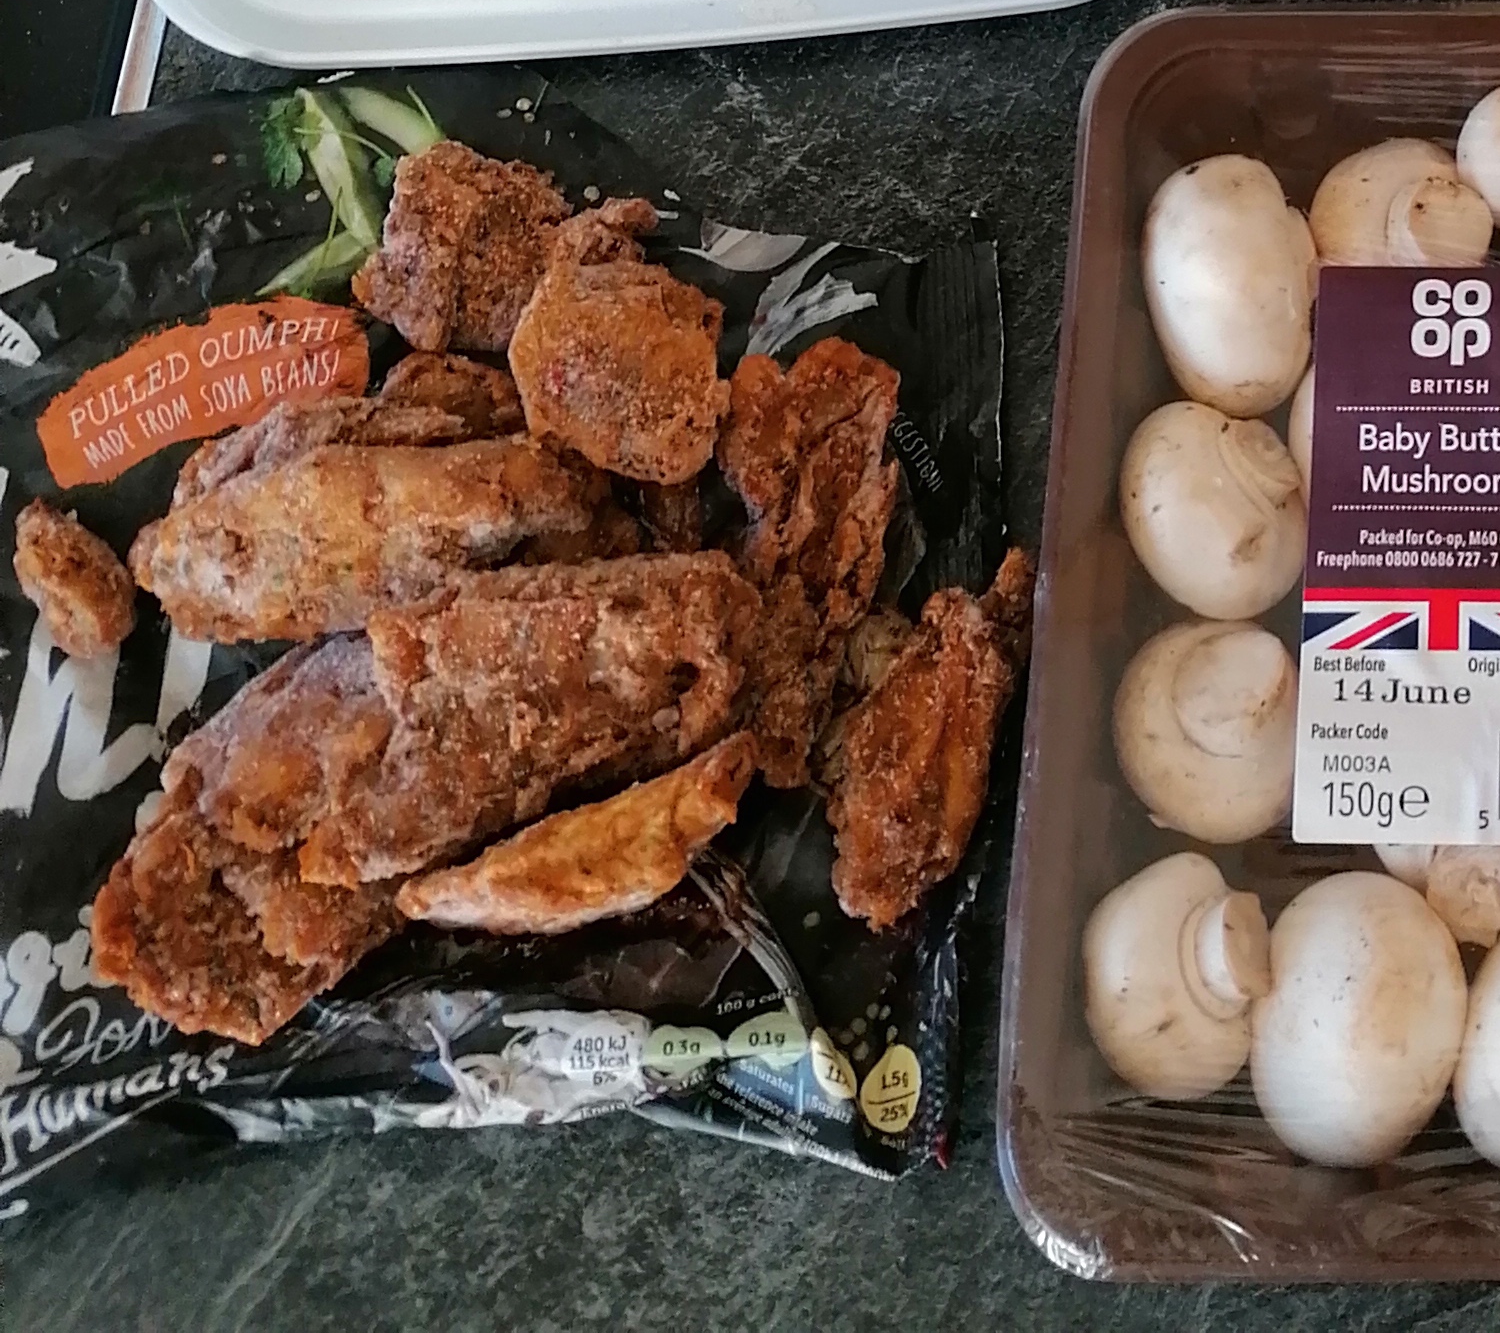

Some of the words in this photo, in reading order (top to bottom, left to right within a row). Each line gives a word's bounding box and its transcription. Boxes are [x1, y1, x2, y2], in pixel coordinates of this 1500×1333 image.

[68, 351, 190, 439] PULLED
[199, 317, 339, 369] OUMPH!
[1410, 379, 1489, 394] BRITISH
[83, 423, 136, 469] MADE
[136, 394, 193, 439] FROM
[200, 373, 252, 418] SOYA
[261, 348, 340, 398] BEANS!
[1359, 423, 1431, 459] Baby
[1360, 529, 1403, 545] Packed
[1406, 529, 1424, 545] for
[1426, 530, 1466, 549] Co-op,
[1469, 531, 1498, 546] M60
[1317, 550, 1383, 570] Freephone
[1385, 550, 1419, 567] 0800
[1421, 550, 1454, 567] 0686
[1457, 551, 1480, 567] 727
[1491, 551, 1498, 567] 7
[1313, 656, 1341, 672] Best
[1344, 655, 1386, 672] Before
[1333, 678, 1375, 702] 14
[1381, 678, 1472, 705] June
[1311, 722, 1351, 739] Packer
[1356, 722, 1389, 740] Code
[1322, 754, 1391, 773] M003A
[573, 1036, 604, 1053] 480
[609, 1035, 627, 1051] kJ
[569, 1055, 595, 1070] 115
[600, 1054, 630, 1068] kcal
[0, 1044, 236, 1176] Humans
